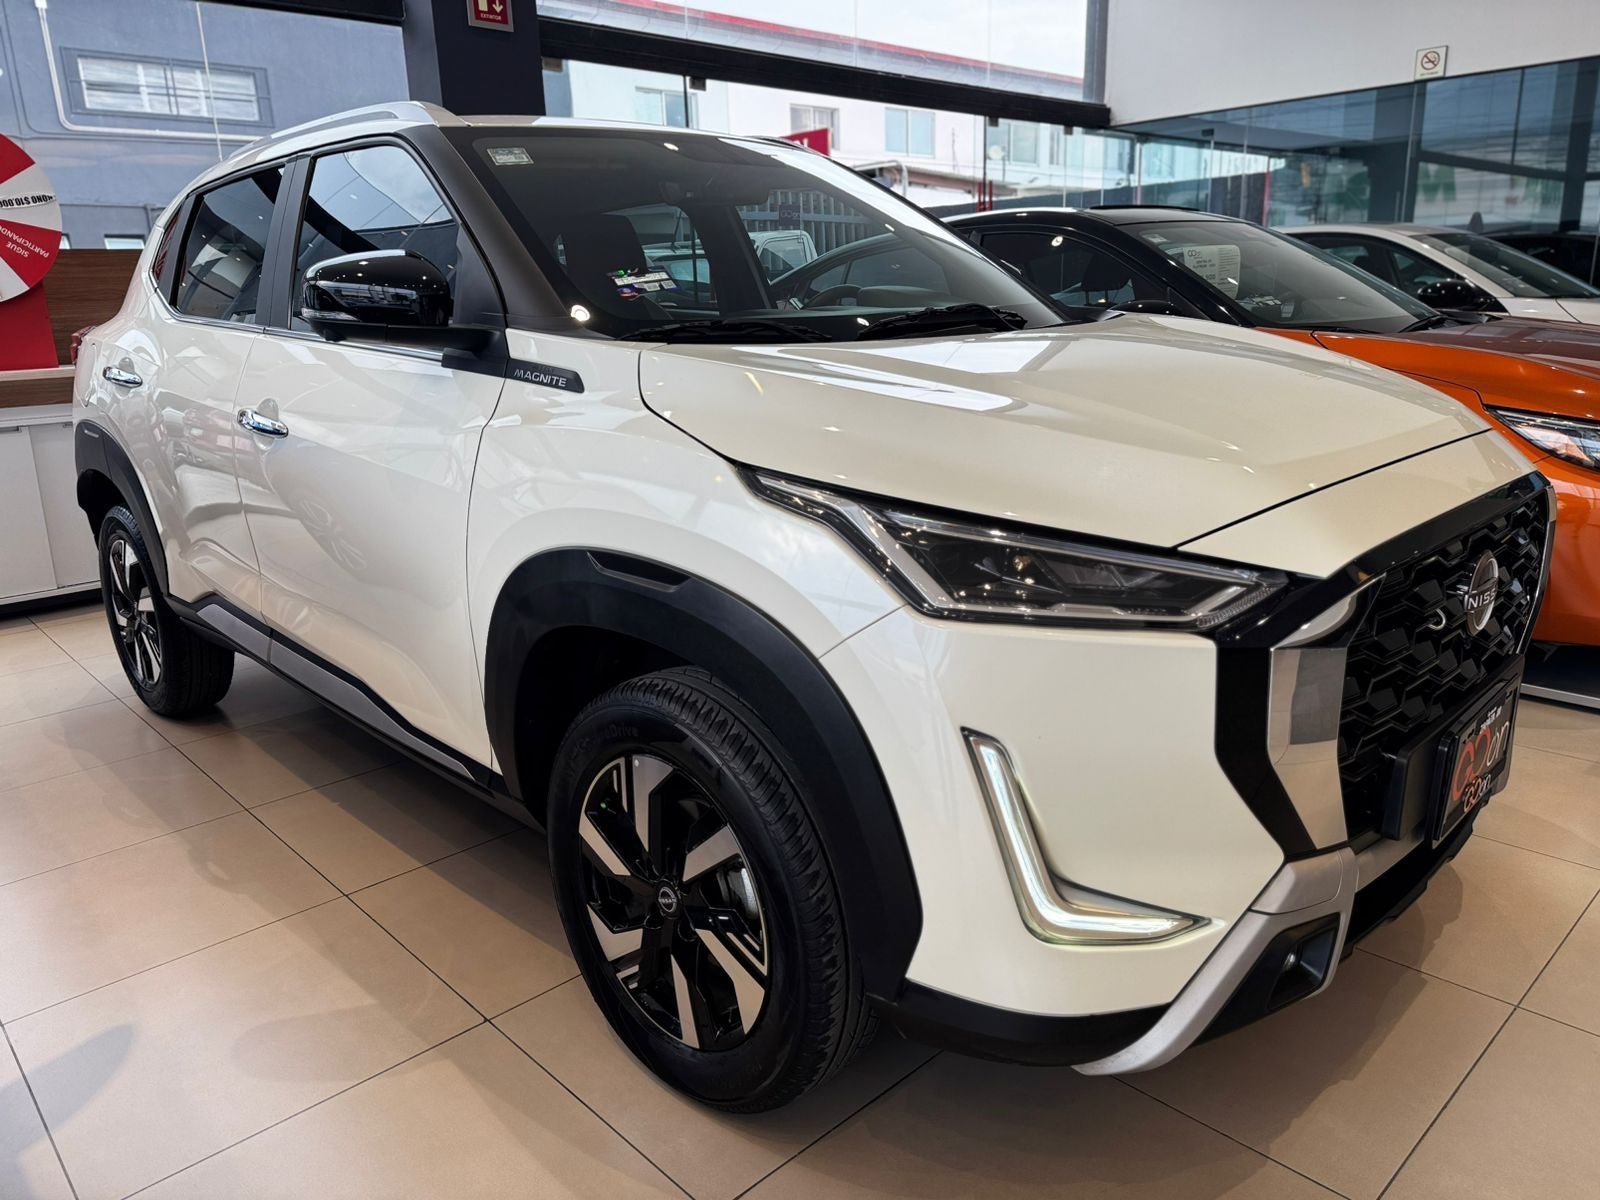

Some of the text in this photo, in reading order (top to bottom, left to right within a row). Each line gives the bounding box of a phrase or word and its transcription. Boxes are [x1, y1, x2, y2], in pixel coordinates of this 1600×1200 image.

[6, 241, 30, 258] SIGUE
[514, 368, 567, 387] MAGNITE
[1467, 588, 1496, 610] NISS
